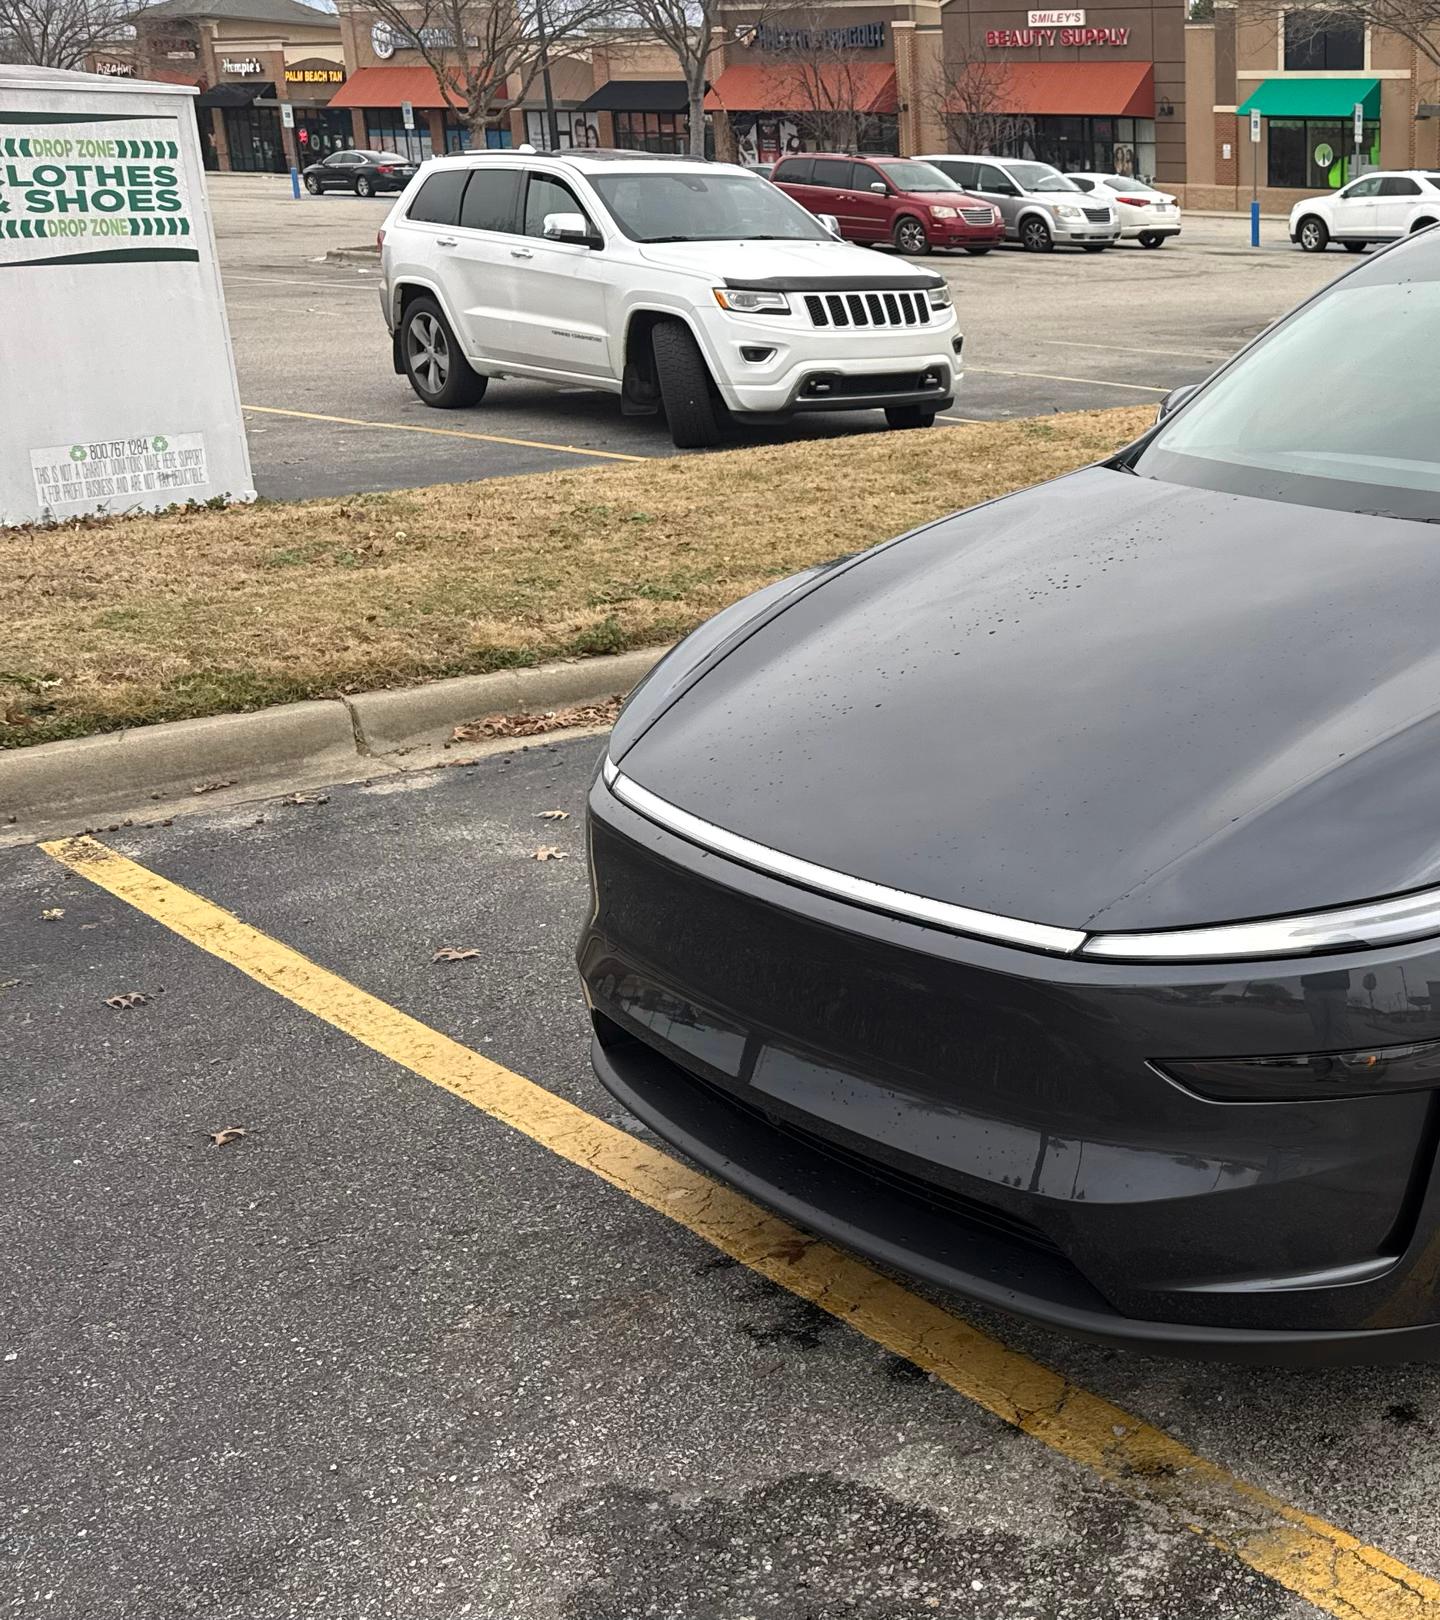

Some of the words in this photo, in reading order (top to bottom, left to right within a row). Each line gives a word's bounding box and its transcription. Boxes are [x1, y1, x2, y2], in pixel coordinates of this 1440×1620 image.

[1030, 12, 1081, 24] SMILEY'S
[986, 29, 1056, 47] BEAUTY
[1060, 28, 1130, 46] SUPPLY
[285, 71, 304, 82] PALM
[305, 71, 328, 82] BEACH
[329, 71, 343, 82] TAN
[32, 138, 74, 158] DROP
[76, 139, 116, 158] ZONE
[0, 164, 178, 187] LOTHES
[25, 188, 182, 213] SHOES
[48, 218, 88, 237] DROP
[90, 218, 129, 237] ZONE
[89, 438, 149, 460] 800.767.1284
[34, 466, 50, 484] THIS
[51, 465, 59, 483] IS
[60, 463, 72, 481] NOT
[75, 463, 81, 480] A
[111, 455, 143, 476] DONATIONS
[178, 448, 204, 468] SUPPORT
